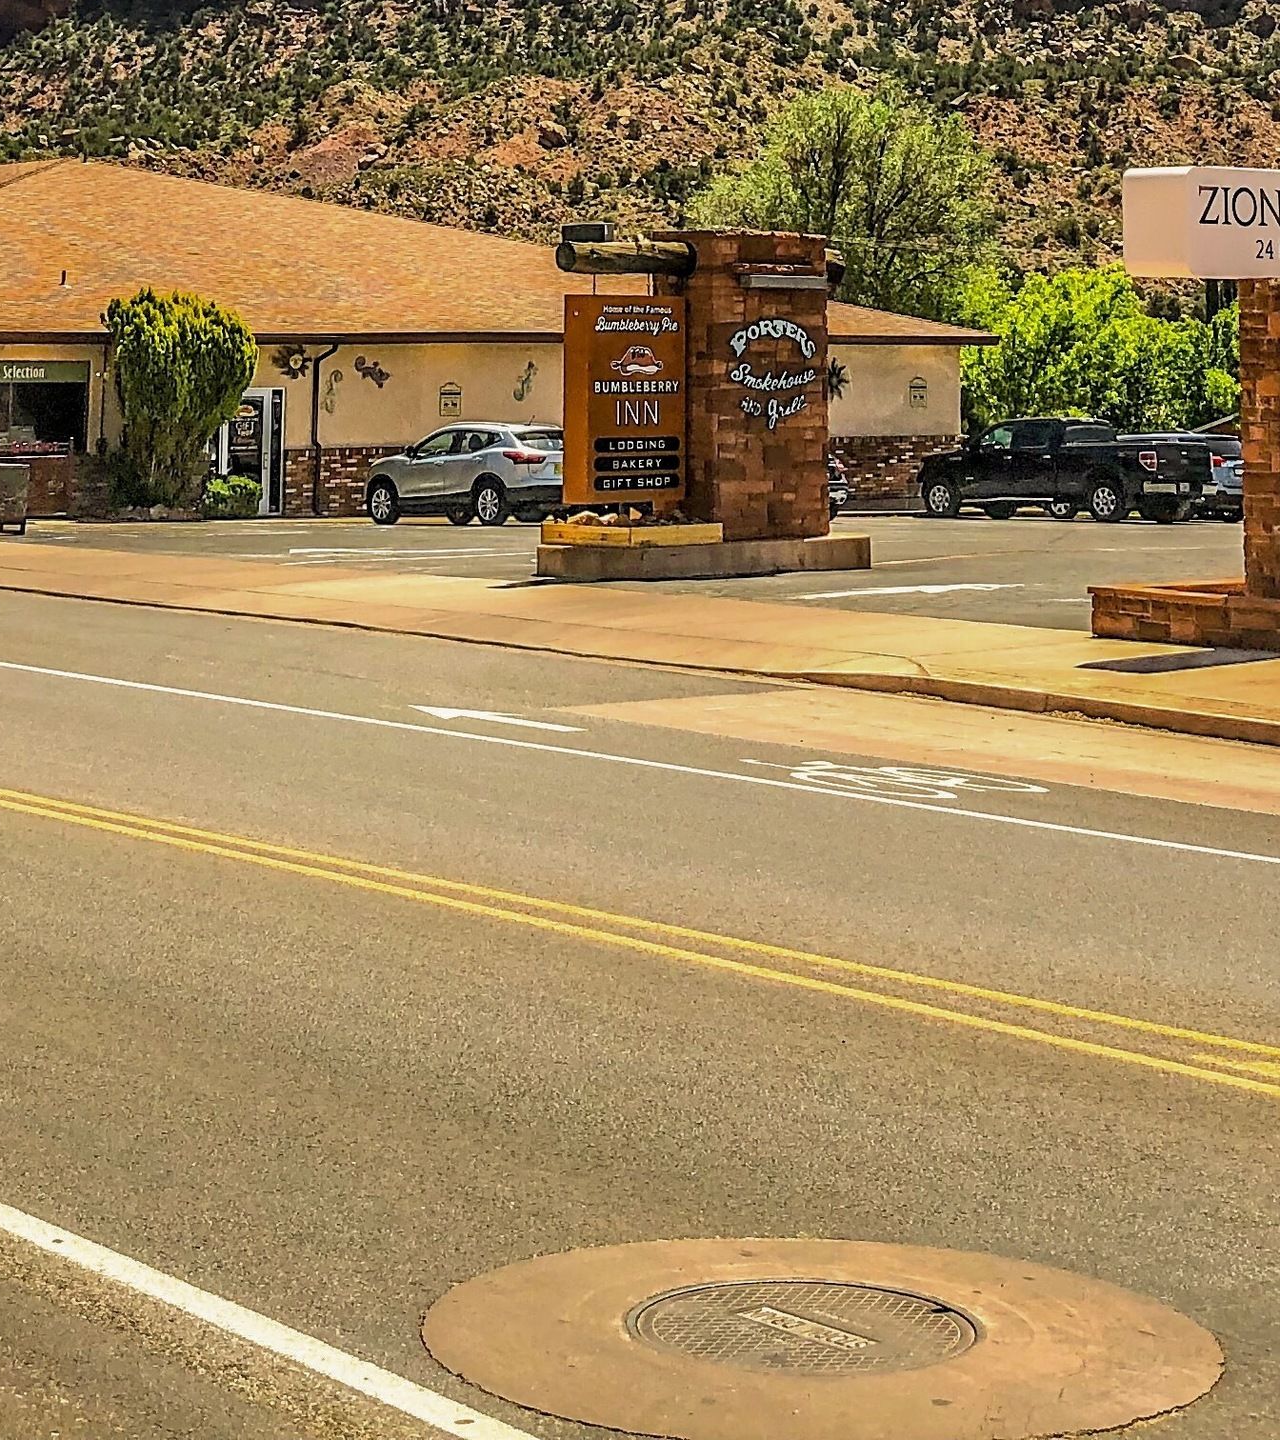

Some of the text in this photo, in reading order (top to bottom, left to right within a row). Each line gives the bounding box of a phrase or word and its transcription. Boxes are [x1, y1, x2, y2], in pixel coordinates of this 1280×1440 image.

[1255, 239, 1274, 260] 24
[603, 305, 672, 314] Home of the Famous
[595, 316, 678, 336] Bumbleberry Pie
[730, 319, 816, 358] PORTERS
[3, 364, 45, 379] Selection
[730, 363, 816, 391] Smokehouse
[594, 380, 679, 393] BUMBLEBERRY
[616, 400, 658, 425] INN
[768, 394, 808, 430] Grill
[609, 439, 666, 450] LODGING
[612, 458, 662, 470] BAKERY
[603, 476, 671, 489] GIFT SHOP
